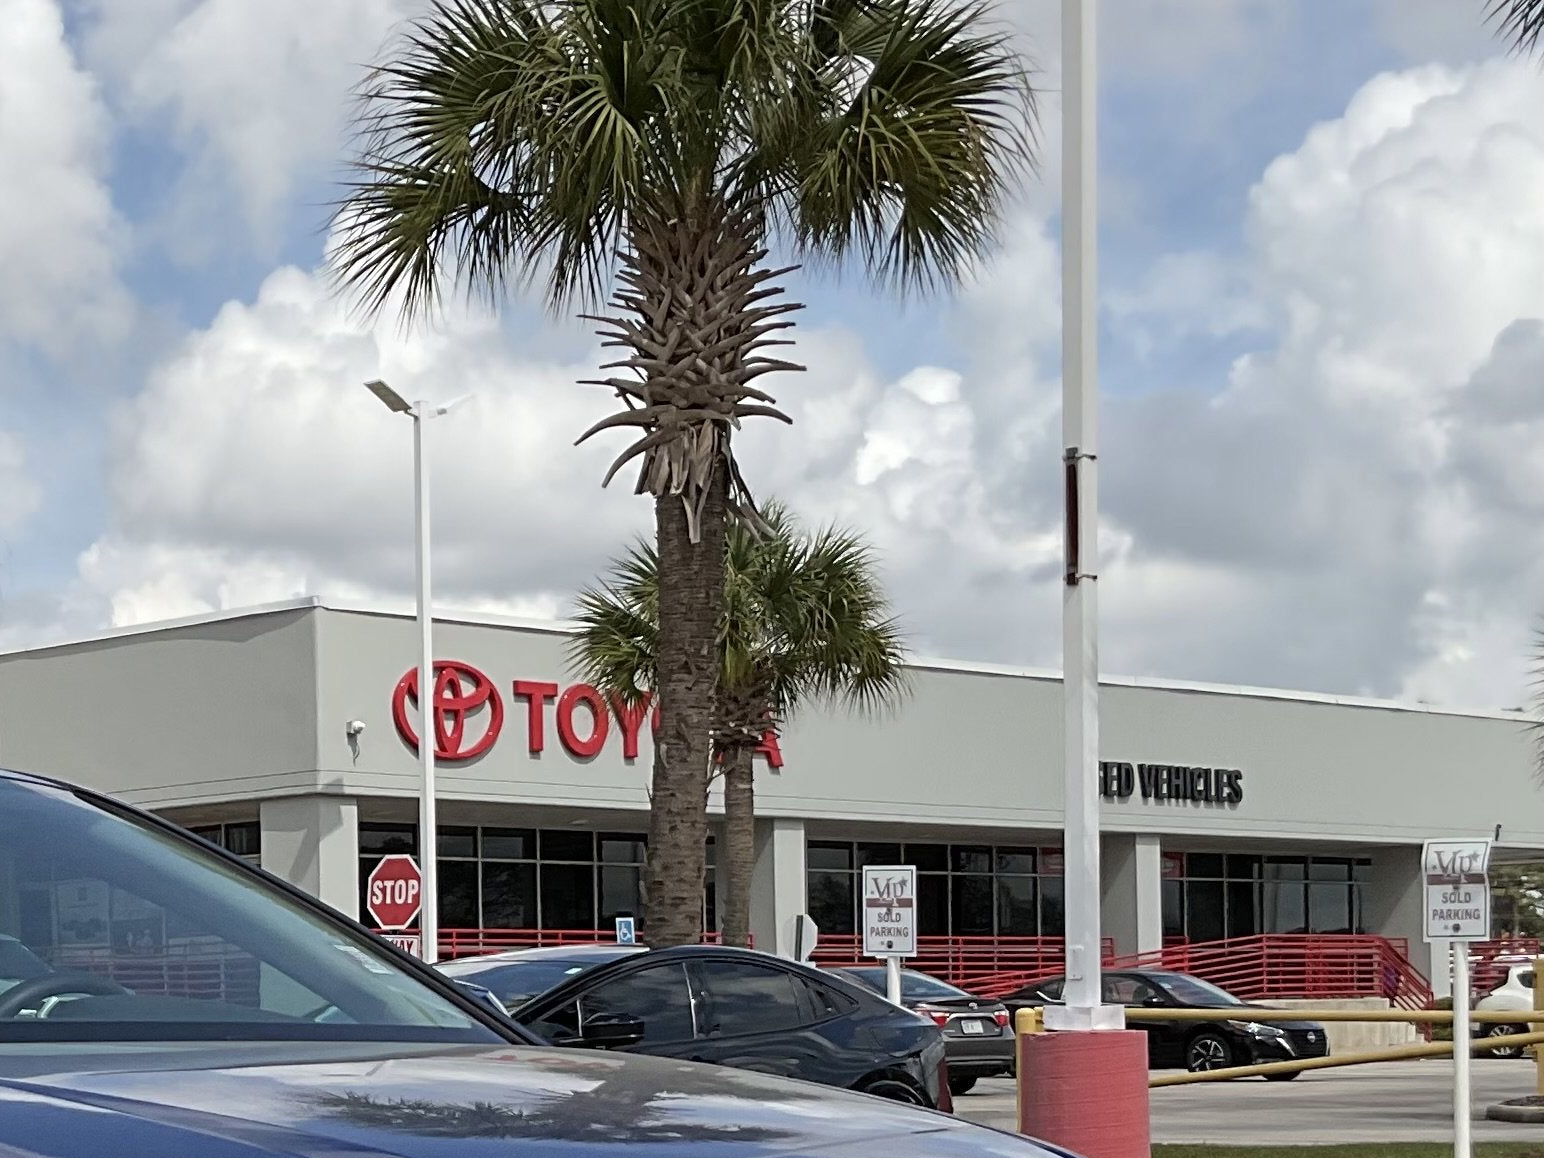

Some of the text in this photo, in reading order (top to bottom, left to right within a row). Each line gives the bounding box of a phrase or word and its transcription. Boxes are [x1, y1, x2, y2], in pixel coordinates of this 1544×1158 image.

[513, 680, 784, 768] TOY
[1137, 764, 1243, 803] VEHICLES
[372, 879, 419, 904] STOP
[1441, 892, 1471, 904] SOLD
[877, 912, 901, 922] SOLD
[1432, 908, 1481, 920] PARKING
[870, 926, 909, 937] PARKING
